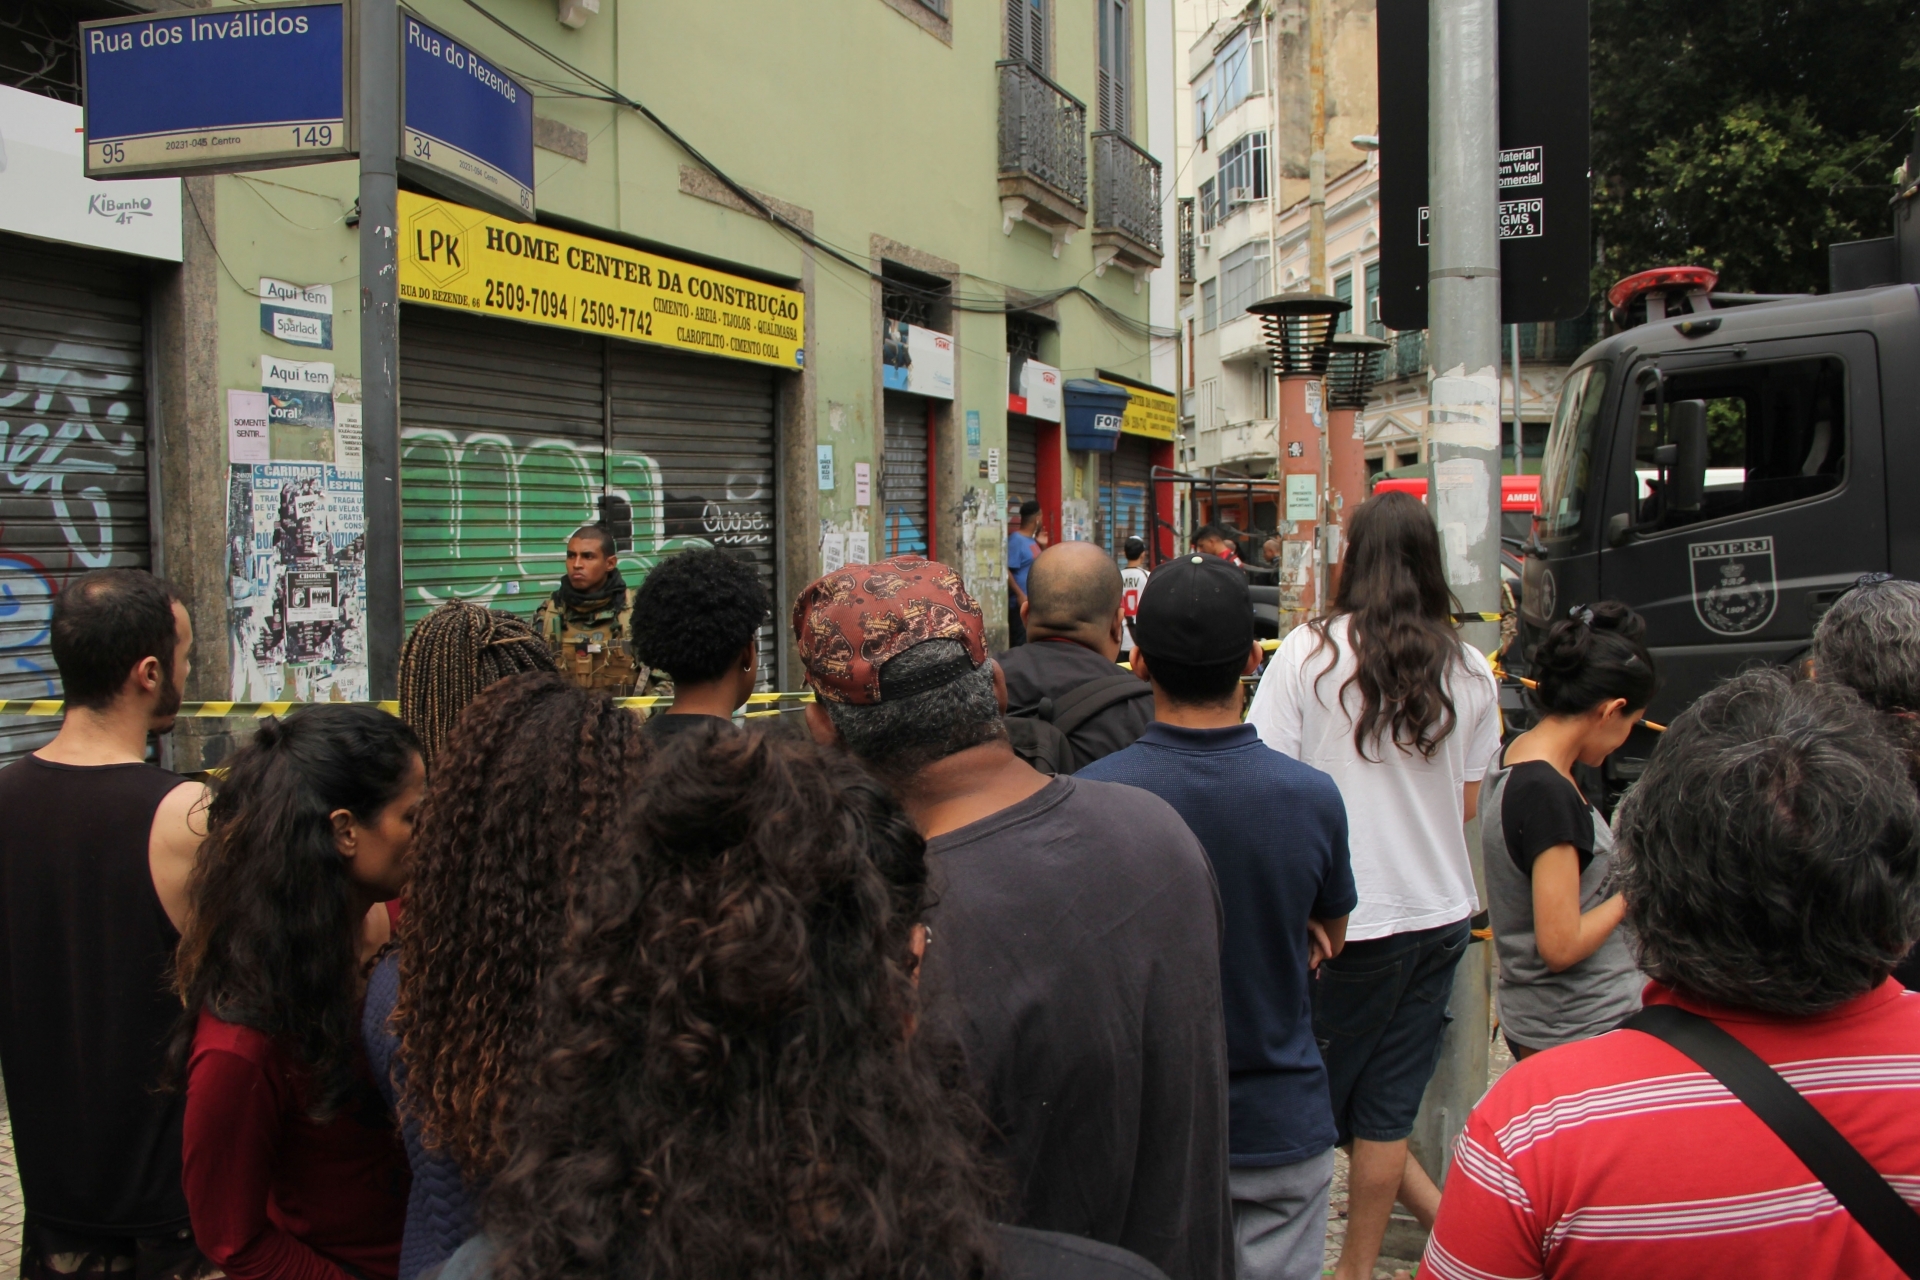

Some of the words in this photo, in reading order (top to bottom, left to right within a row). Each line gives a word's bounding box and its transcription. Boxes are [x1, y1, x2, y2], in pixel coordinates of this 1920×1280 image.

[90, 31, 132, 54] Rua
[140, 23, 183, 47] dos
[191, 11, 309, 42] Inválidos
[409, 21, 441, 58] Rua
[445, 43, 464, 70] do
[468, 53, 516, 104] Rezende
[211, 135, 241, 146] Centro
[292, 125, 332, 148] 149
[102, 143, 125, 164] 95
[413, 136, 431, 161] 34
[1499, 165, 1511, 175] em
[1513, 162, 1540, 174] Valor
[484, 171, 499, 185] Centro
[1499, 172, 1541, 186] omercial
[520, 188, 530, 210] 66
[1499, 201, 1541, 215] ET-RIO
[417, 229, 461, 269] LPK
[485, 226, 560, 265] HOME
[566, 246, 653, 287] CENTER
[657, 268, 684, 294] DA
[687, 276, 799, 321] CONSTRUÇÃO
[268, 283, 297, 301] Aqui
[302, 290, 327, 304] tem
[400, 284, 417, 297] RUA
[418, 287, 430, 299] DO
[472, 298, 481, 308] 66
[485, 278, 568, 320] 2509-7094
[580, 298, 653, 336] 2509-7742
[278, 318, 318, 336] Sparlack
[653, 297, 689, 318] CIMENTO
[695, 306, 717, 324] AREIA
[722, 312, 751, 331] TIJOLOS
[757, 320, 798, 341] QUALIMASSA
[677, 326, 725, 349] CLAROFILITO
[730, 336, 761, 356] CIMENTO
[762, 343, 780, 360] COLA
[270, 365, 300, 383] Aqui
[304, 370, 329, 384] tem
[268, 404, 298, 419] Coral
[234, 418, 267, 427] SOMENTE
[264, 465, 322, 477] CARIDADE
[333, 496, 355, 504] TRAGA
[1506, 493, 1537, 502] AMBU
[255, 504, 265, 512] DE
[338, 505, 360, 513] VELAS
[1694, 540, 1768, 557] PMERJ
[1726, 605, 1746, 614] 1809
